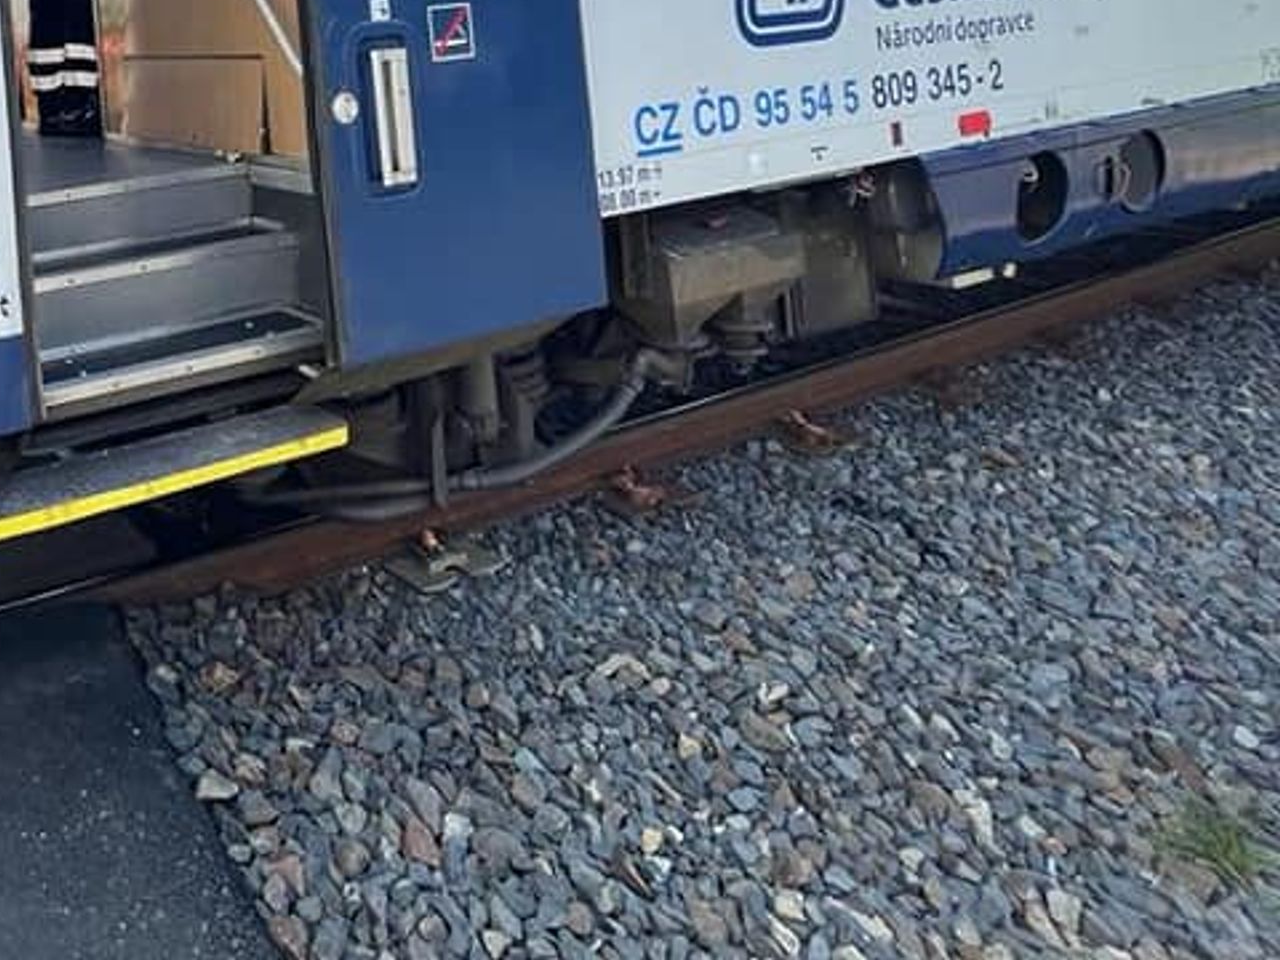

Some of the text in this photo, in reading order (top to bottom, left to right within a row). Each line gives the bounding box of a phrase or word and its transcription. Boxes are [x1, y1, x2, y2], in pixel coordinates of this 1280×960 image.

[954, 12, 1034, 44] dopravce
[634, 102, 682, 147] CZ
[693, 87, 741, 137] ČD
[754, 87, 791, 128] 95
[800, 81, 834, 121] 54
[843, 80, 859, 114] 5
[871, 70, 918, 109] 809
